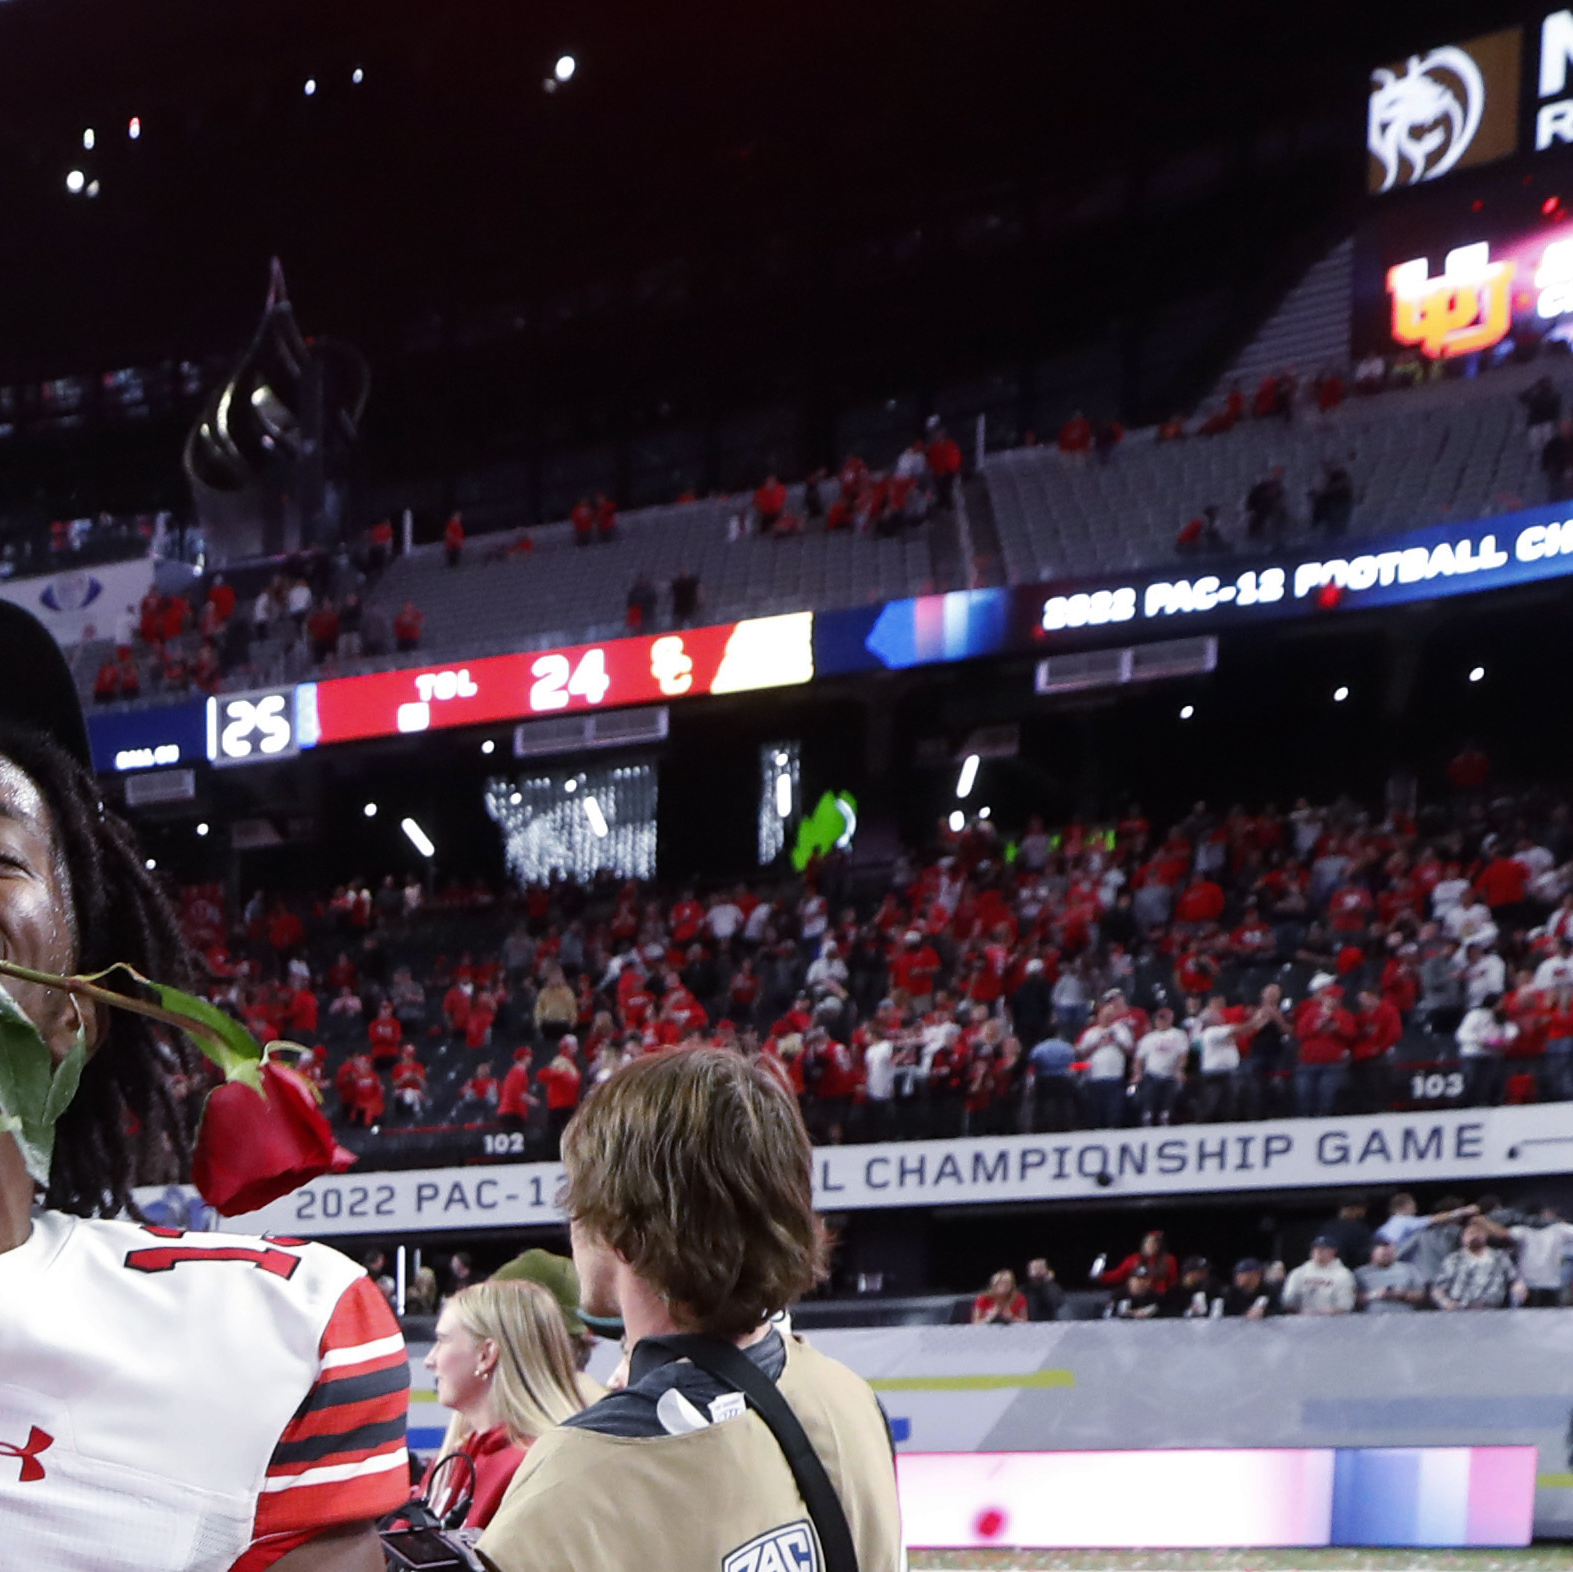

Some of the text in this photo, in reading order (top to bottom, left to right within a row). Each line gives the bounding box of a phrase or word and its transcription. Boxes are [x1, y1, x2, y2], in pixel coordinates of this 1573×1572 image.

[1294, 534, 1509, 598] FOOTBALL
[529, 647, 610, 712] 24
[221, 695, 291, 758] 25
[1412, 1070, 1466, 1098] 103
[483, 1131, 525, 1155] 102
[863, 1134, 1294, 1191] CHAMPIONSHIP
[1315, 1122, 1486, 1168] GAME
[295, 1185, 396, 1221] 2022
